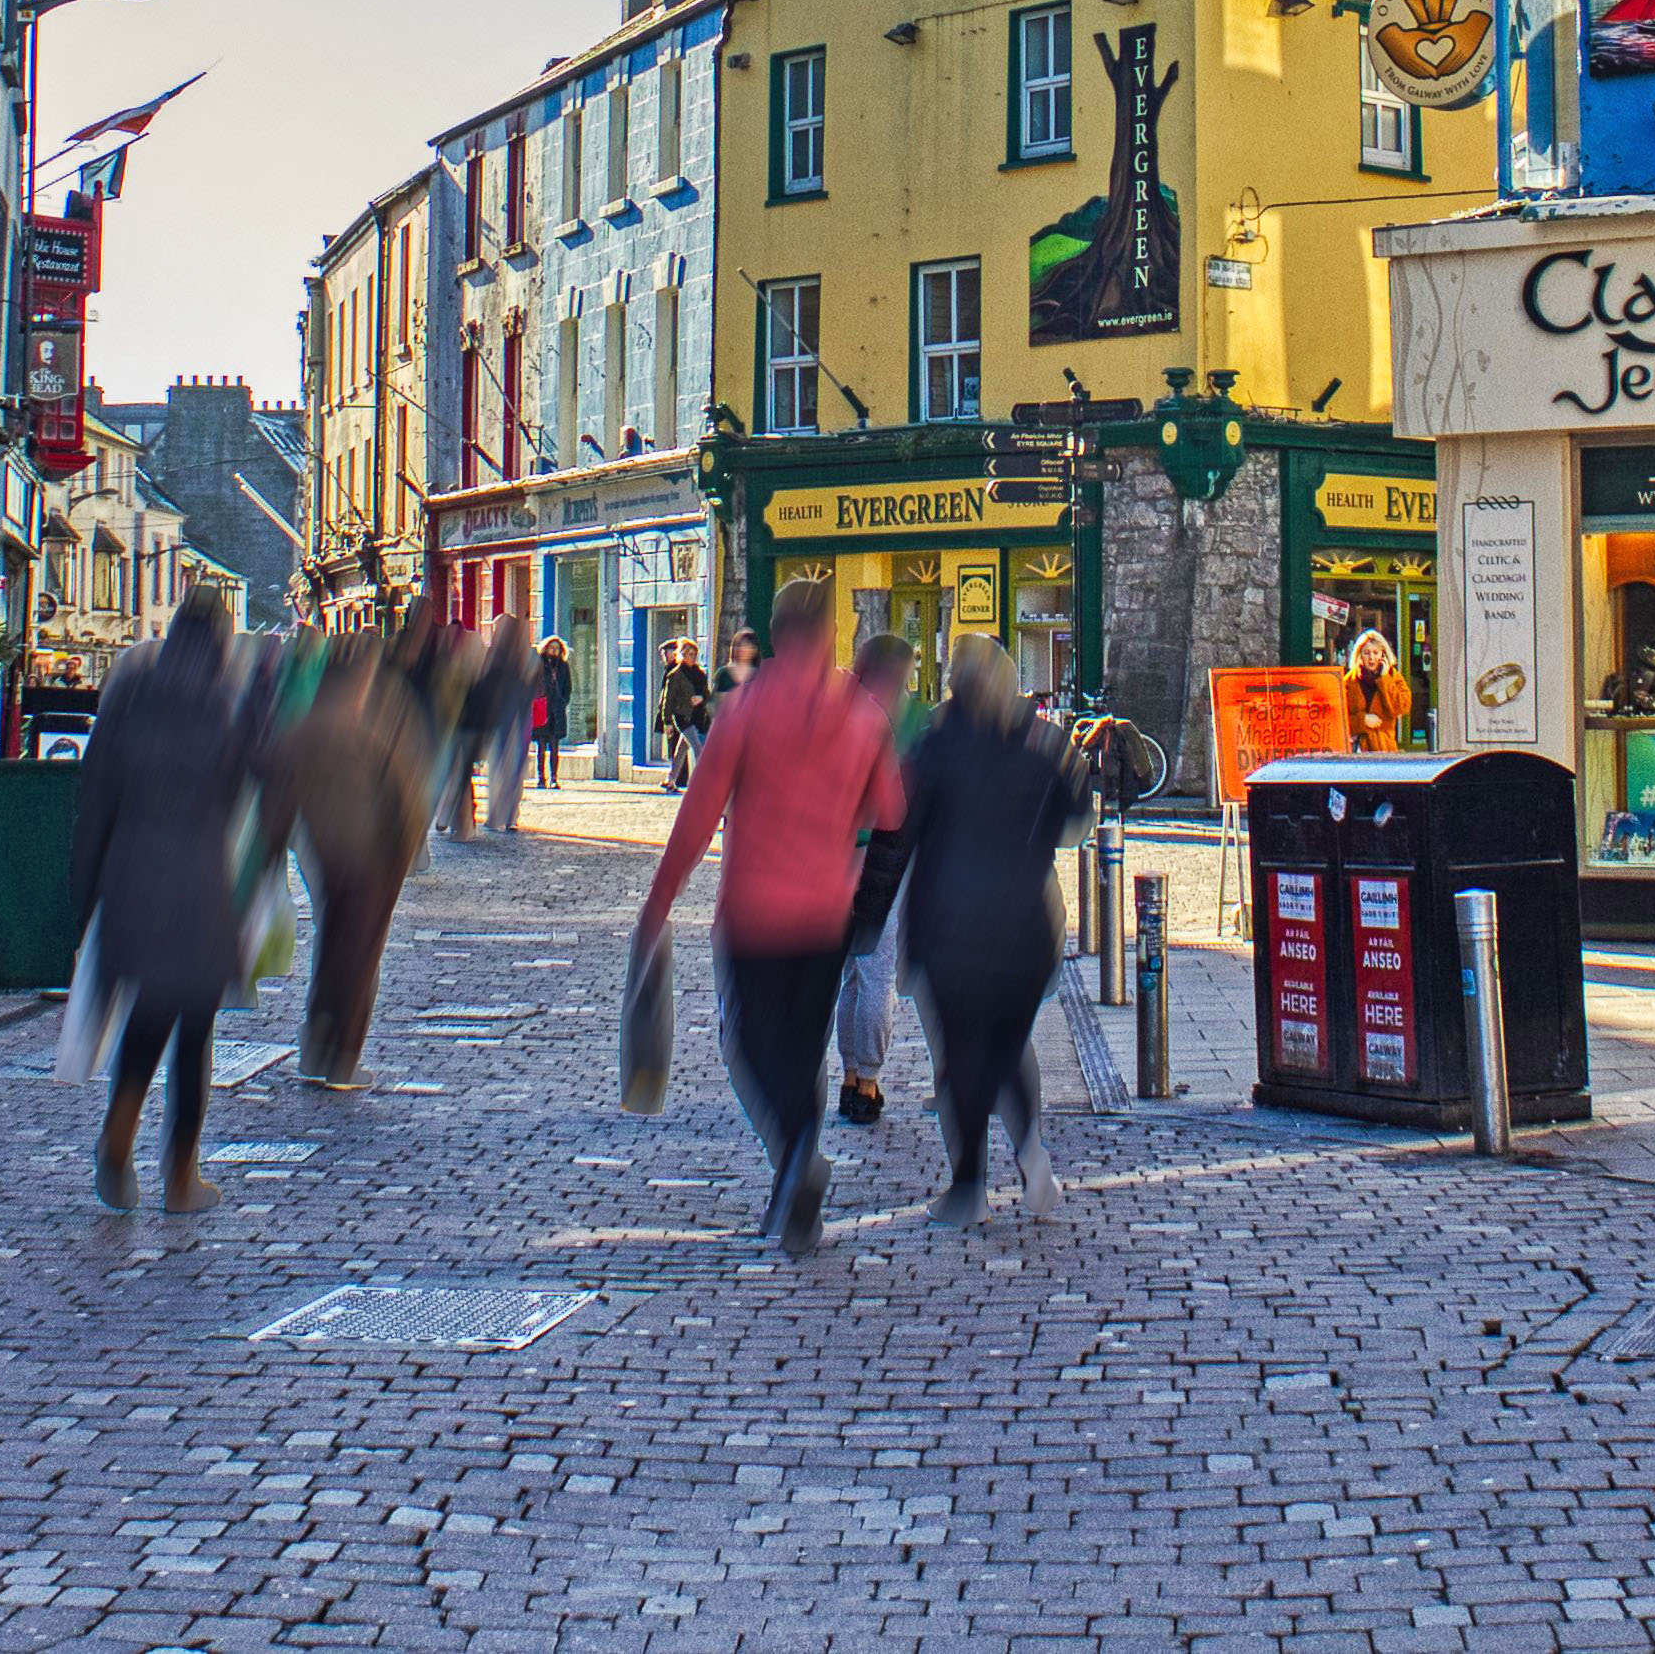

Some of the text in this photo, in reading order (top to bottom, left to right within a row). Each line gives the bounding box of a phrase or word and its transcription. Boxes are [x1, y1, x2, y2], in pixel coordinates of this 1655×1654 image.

[1385, 54, 1488, 100] FROM GALWAY WITH LOVE
[1133, 37, 1150, 289] EVERGREEN
[52, 239, 79, 255] House
[1097, 309, 1173, 328] www.evergreen.ie
[778, 486, 986, 530] HEALTH EVERGREEN
[1326, 492, 1374, 509] HEALTH
[1477, 555, 1512, 566] CELTIC
[1472, 573, 1527, 584] CLADDAGH
[962, 581, 991, 603] EVERGREEN
[1476, 591, 1525, 602] WEDDING
[962, 605, 990, 614] CORNER
[1484, 610, 1516, 620] BANDS
[1236, 698, 1303, 721] Trácht
[1236, 723, 1304, 745] Mhalairt
[1279, 883, 1314, 897] GAILLIMH
[1360, 891, 1397, 904] GAILLIMH
[1280, 941, 1317, 961] ANSEO
[1363, 950, 1401, 971] ANSEO
[1281, 992, 1317, 1016] HERE
[1365, 1003, 1404, 1027] HERE
[1284, 1028, 1316, 1045] GALWAY
[1368, 1043, 1402, 1057] GALWAY
